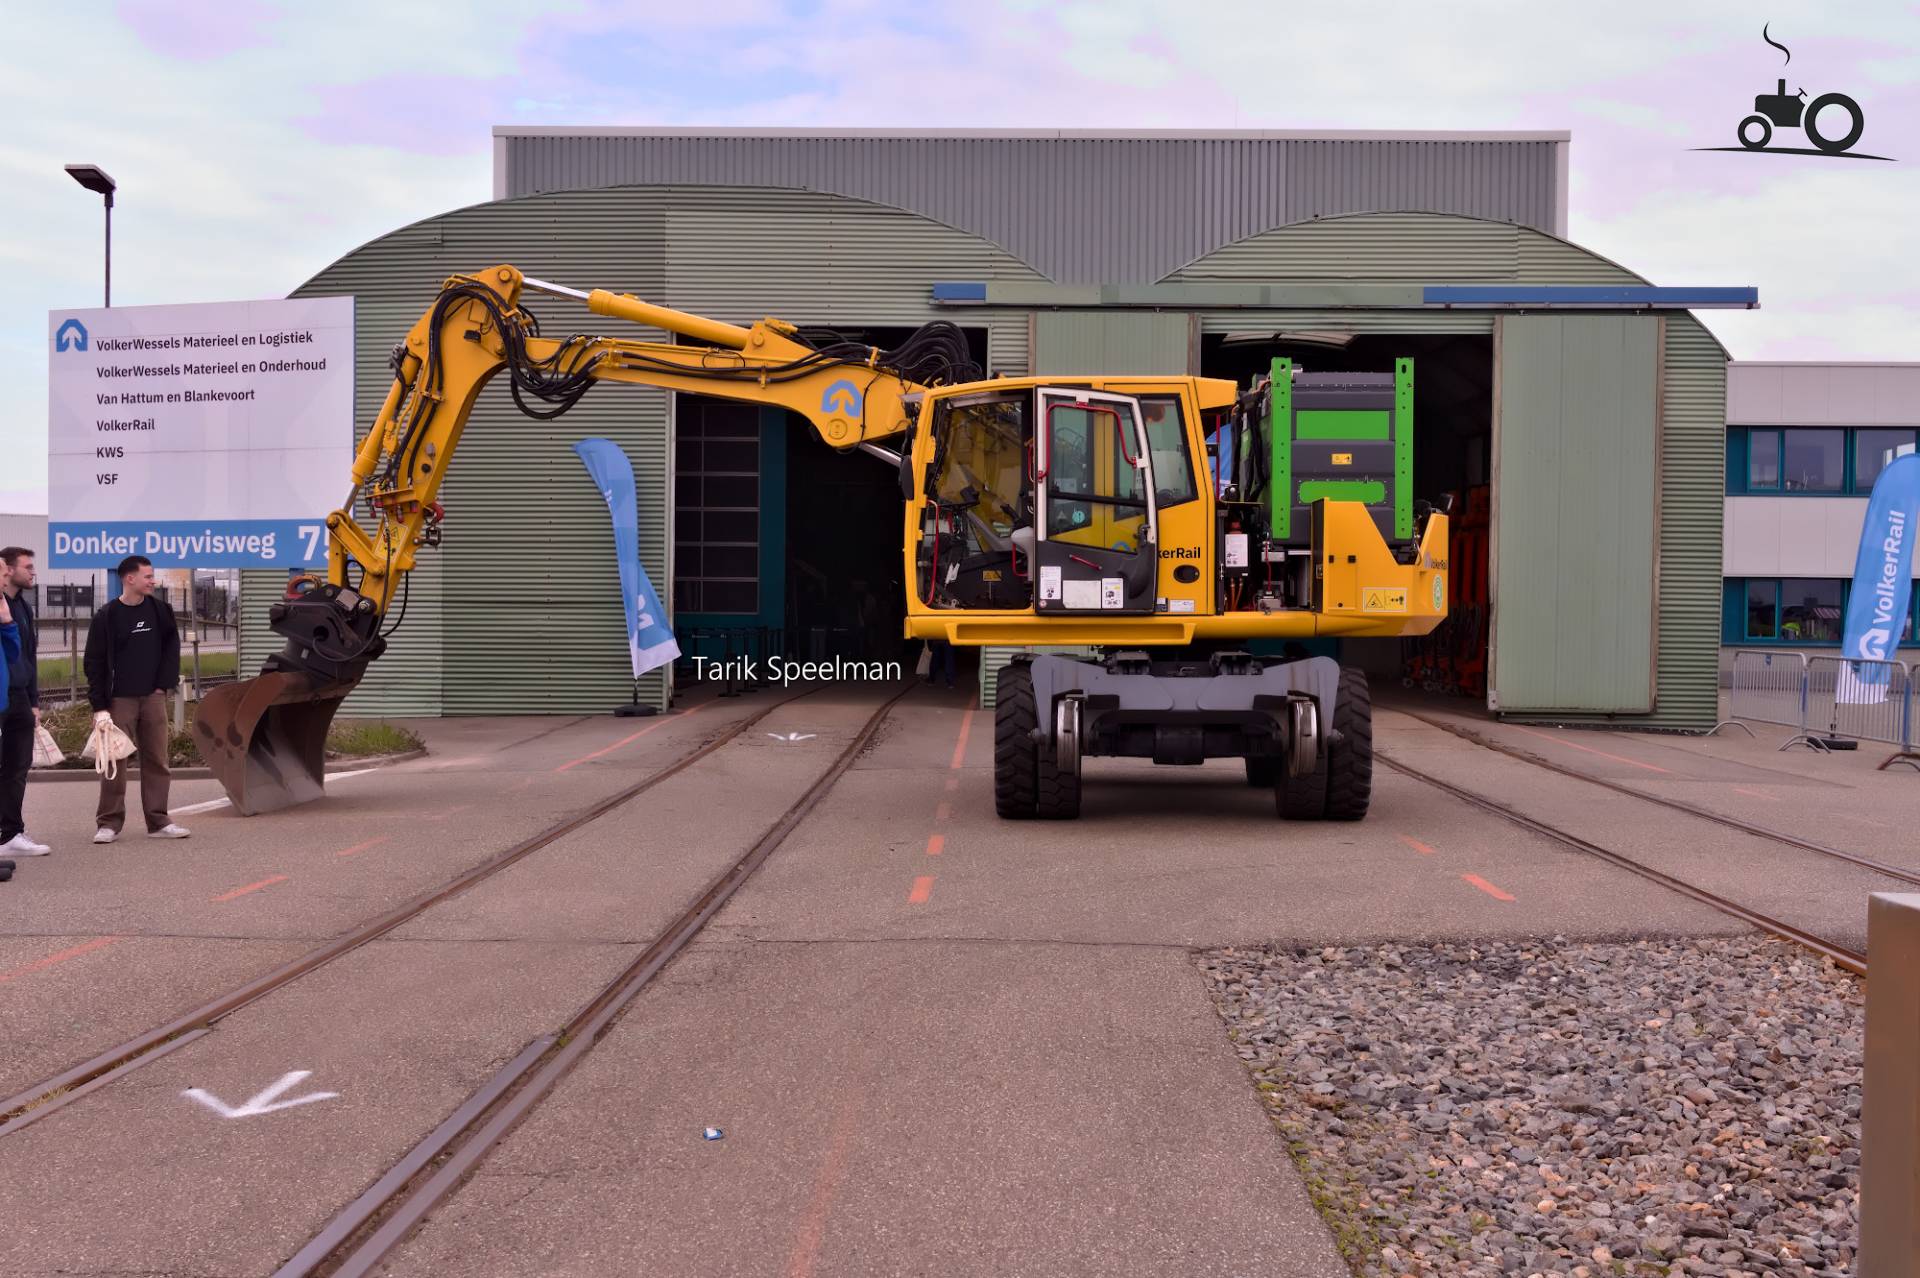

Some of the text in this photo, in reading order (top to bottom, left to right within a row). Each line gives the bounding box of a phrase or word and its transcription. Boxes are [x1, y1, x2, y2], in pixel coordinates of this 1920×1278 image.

[96, 331, 313, 352] VolkerWessels Materieel en Logistiek
[96, 358, 327, 378] VolkerWessels Materieel en Onderhoud
[96, 389, 255, 405] Van Hattum en Blankevoort
[96, 418, 155, 432] VolkerRail
[96, 446, 124, 459] KWS
[96, 473, 119, 485] VSF
[55, 525, 330, 561] Donker Duyvisweg 7
[1872, 510, 1906, 624] VolkerRail
